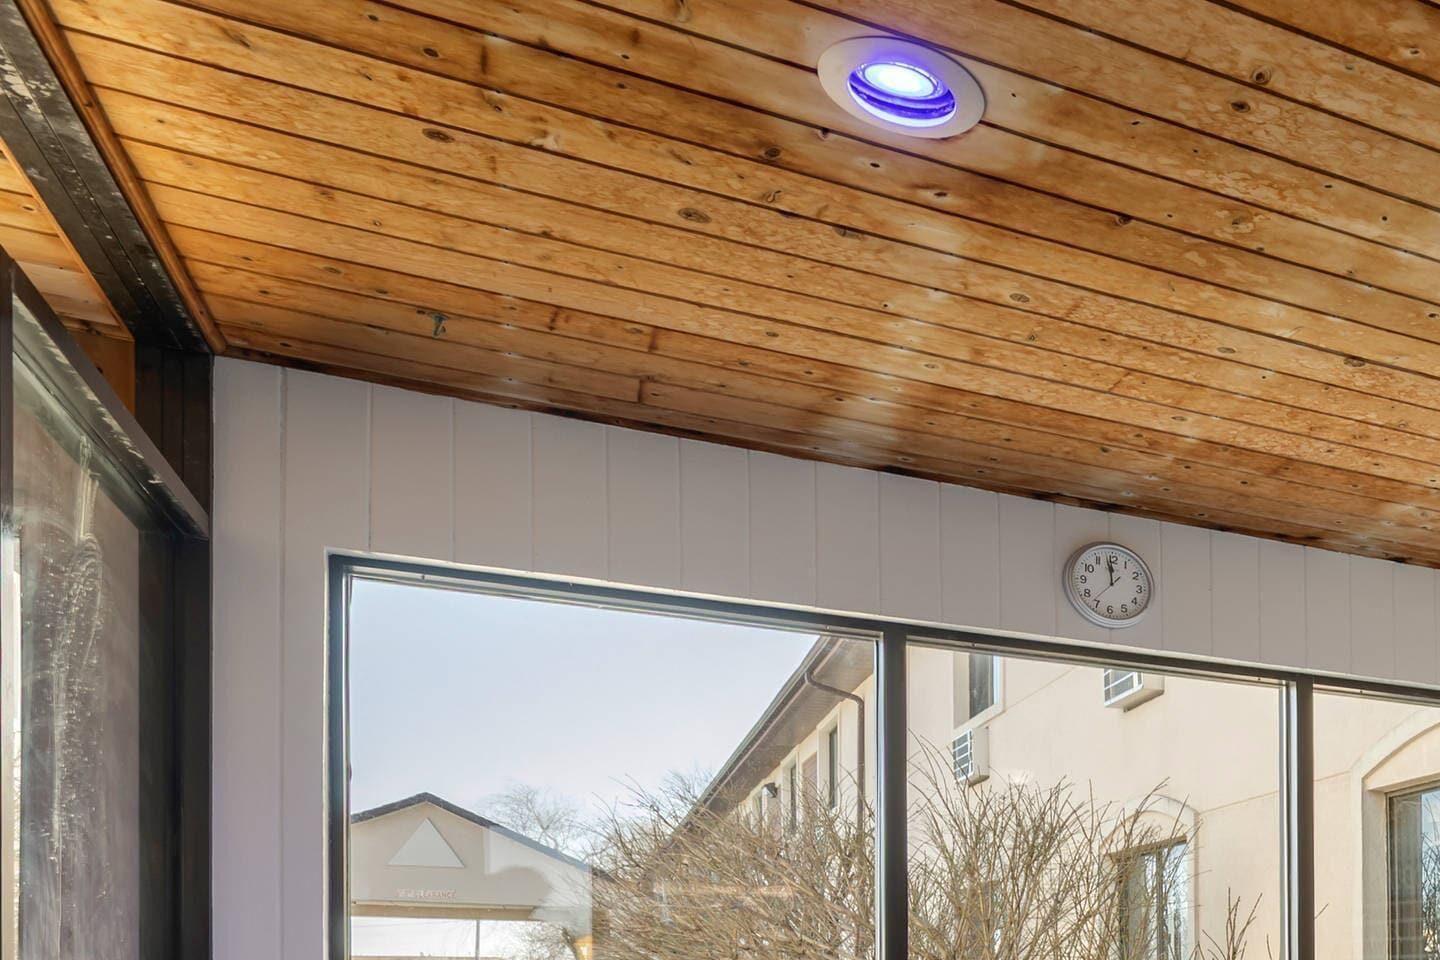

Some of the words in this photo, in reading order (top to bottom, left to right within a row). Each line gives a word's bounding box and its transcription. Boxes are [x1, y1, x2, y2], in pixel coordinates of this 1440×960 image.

[1095, 556, 1101, 565] 11
[1109, 555, 1118, 565] 12
[1084, 563, 1094, 573] 10
[1080, 575, 1087, 584] 9
[1132, 571, 1139, 580] 2
[1083, 588, 1091, 598] 8
[1136, 585, 1143, 594] 3
[1093, 599, 1100, 608] 7
[1131, 597, 1137, 605] 4
[1106, 605, 1113, 614] 6
[1121, 604, 1128, 613] 5
